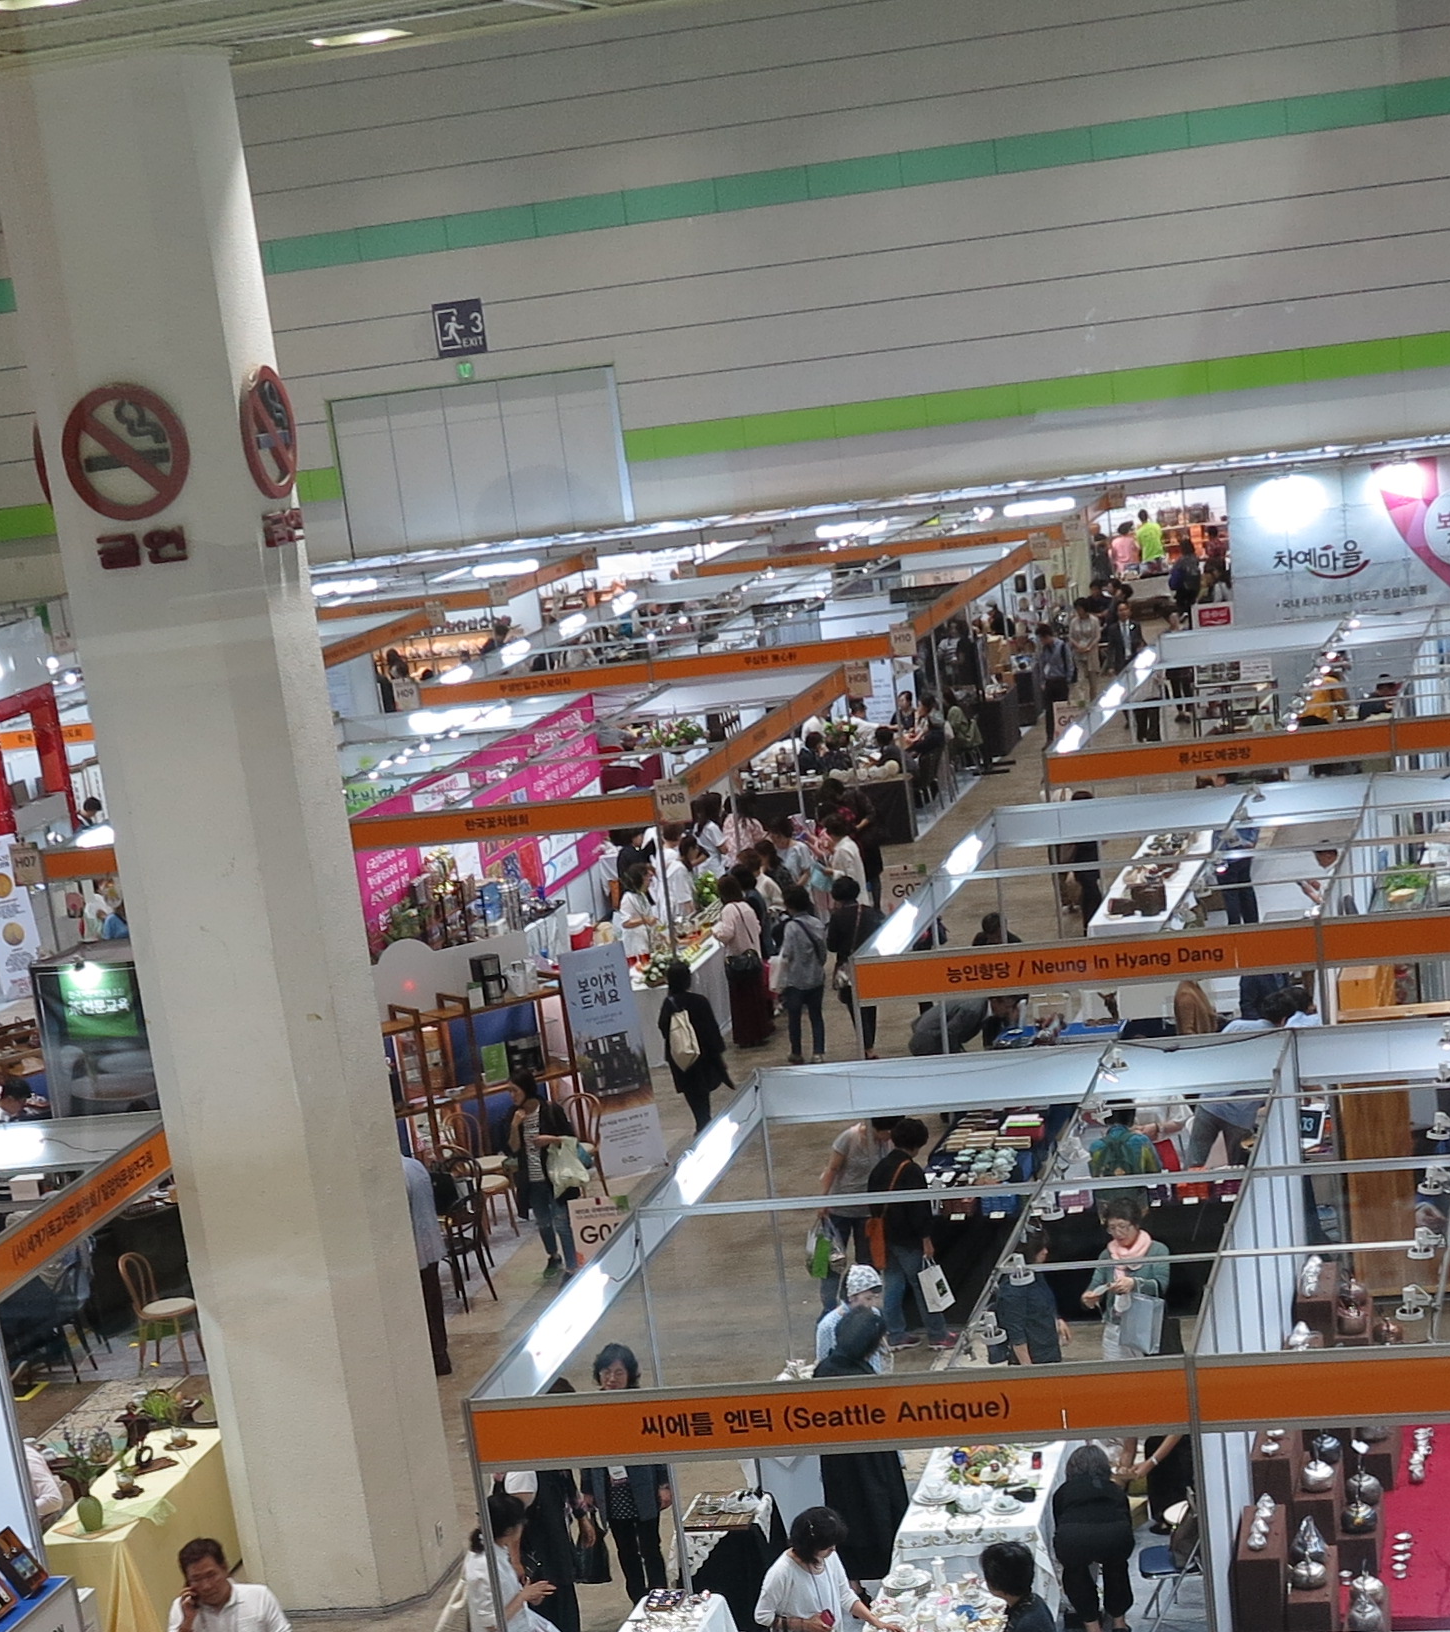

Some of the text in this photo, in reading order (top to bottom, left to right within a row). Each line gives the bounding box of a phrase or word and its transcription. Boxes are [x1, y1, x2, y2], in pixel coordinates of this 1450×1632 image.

[470, 312, 483, 333] 3
[462, 336, 484, 348] EXIT
[96, 525, 189, 570] 금연
[1272, 538, 1371, 573] 차예마을
[396, 687, 416, 700] H09
[660, 791, 686, 806] H08
[465, 814, 529, 832] 한국꽃차협회
[14, 854, 37, 870] H07
[945, 960, 1012, 983] 능인향당
[1031, 956, 1089, 981] Neung
[1093, 953, 1110, 970] In
[1115, 951, 1173, 973] Hyang
[1177, 945, 1225, 968] Dang
[577, 972, 617, 994] 보이차
[580, 990, 622, 1010] 드세요
[579, 1221, 620, 1245] G0
[640, 1392, 1013, 1441] 씨에틀 엔틱 (Seattle Antique)
